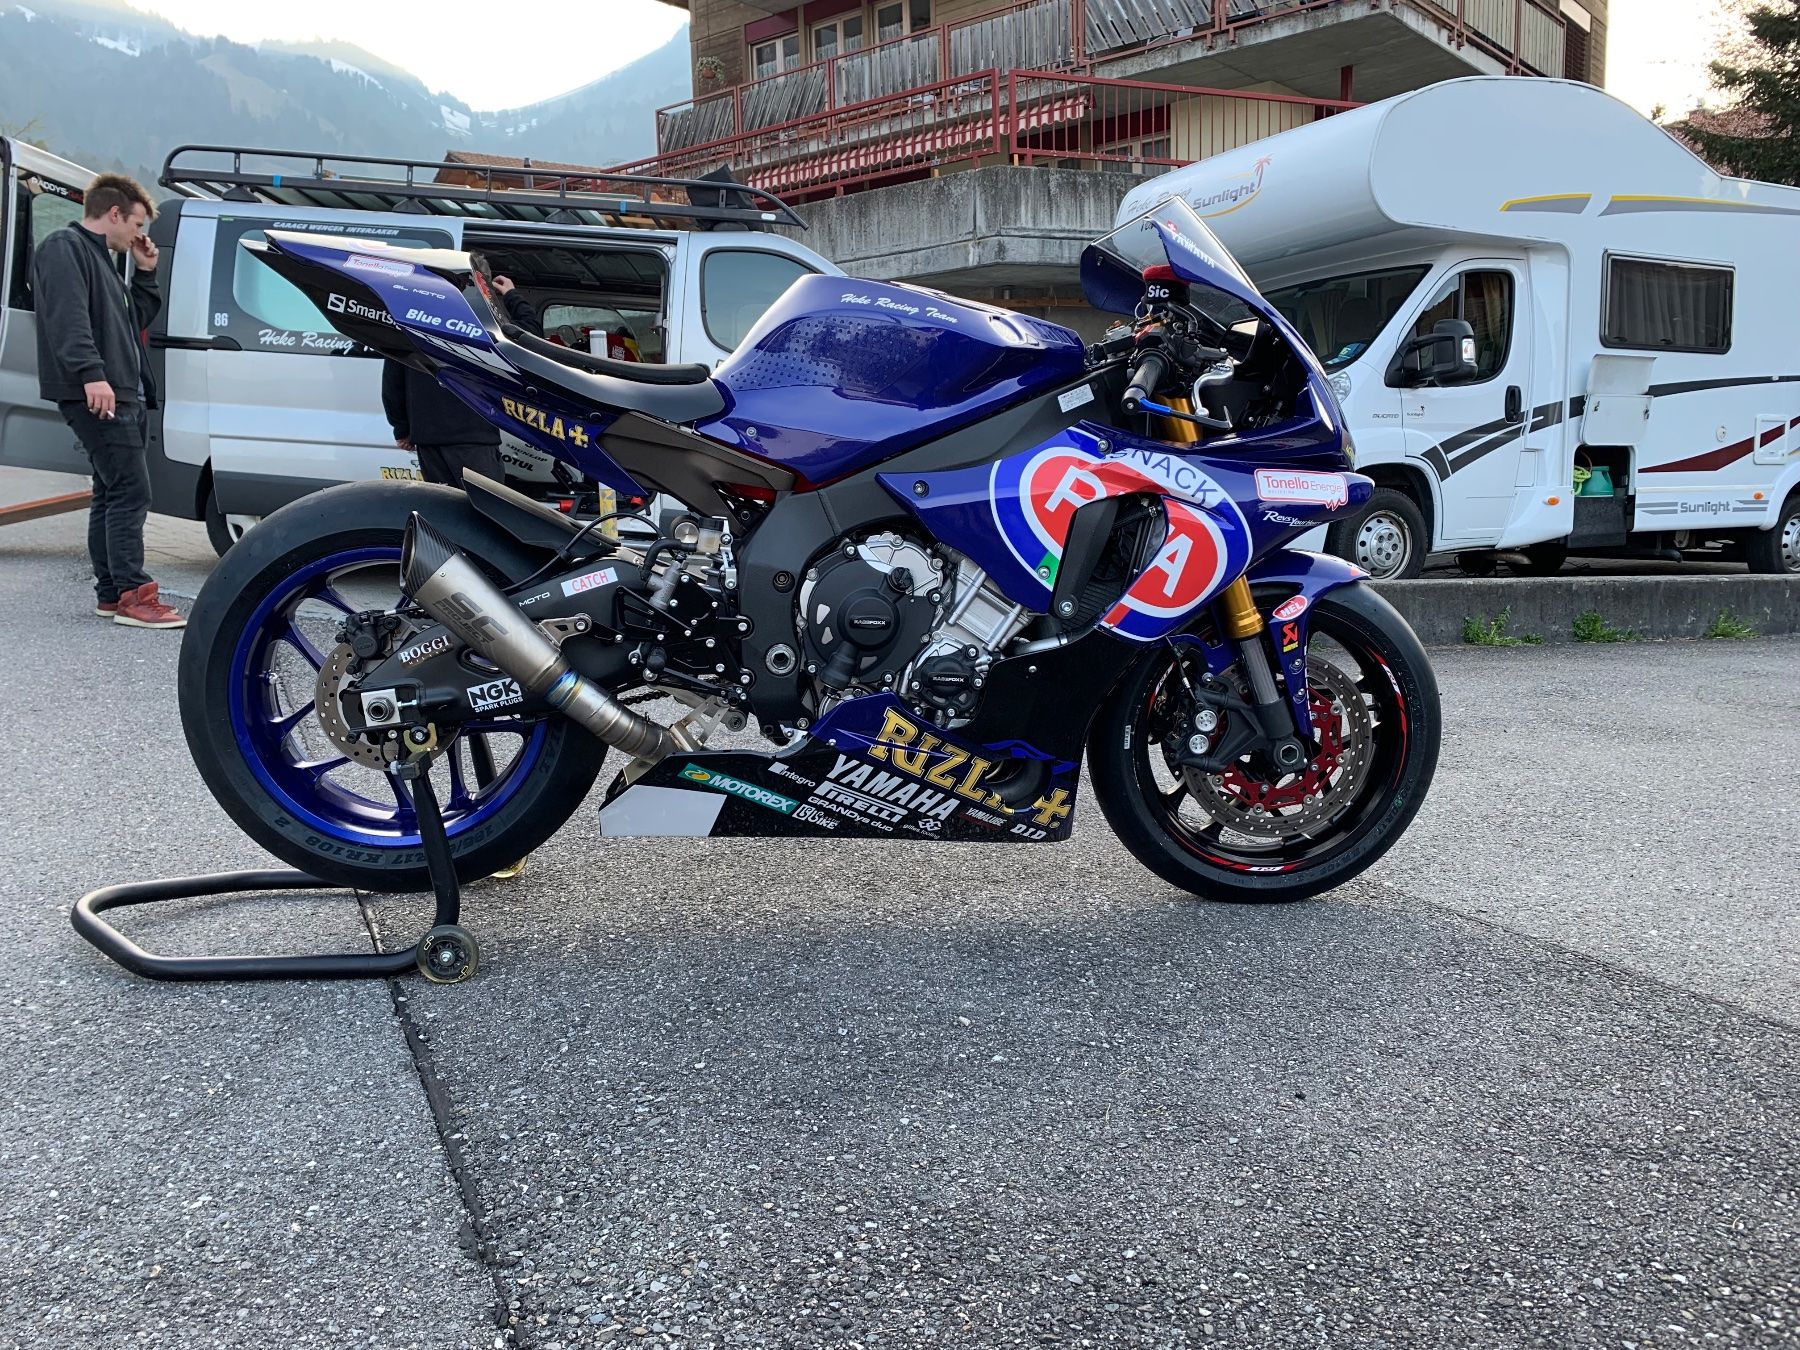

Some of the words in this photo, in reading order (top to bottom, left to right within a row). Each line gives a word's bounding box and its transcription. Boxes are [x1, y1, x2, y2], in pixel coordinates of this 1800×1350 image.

[1193, 182, 1256, 210] Sunlight
[273, 222, 308, 230] GARAGE
[309, 224, 345, 232] WENGER
[346, 226, 400, 236] INTERLAKEN
[1147, 285, 1170, 298] Sic
[214, 312, 228, 327] 86
[347, 299, 402, 331] Smarts
[841, 293, 871, 305] Heke
[874, 297, 920, 314] Racing
[925, 307, 959, 324] Team
[405, 308, 442, 326] Blue
[445, 318, 483, 338] Chip
[259, 328, 296, 345] Heke
[301, 332, 354, 355] Racing
[500, 452, 534, 472] OTUL
[1263, 475, 1309, 490] Tonello
[1263, 510, 1293, 523] Revs
[1680, 501, 1731, 516] Sunlight
[1044, 465, 1194, 598] PA
[571, 571, 609, 593] CATCH
[518, 591, 550, 607] MOTO
[399, 634, 450, 663] BOGGI
[468, 680, 519, 707] NGK
[474, 701, 500, 713] SPARK
[500, 695, 524, 707] PLUGS
[867, 705, 1015, 815] RIZL
[779, 765, 816, 788] integro
[826, 753, 961, 821] YAMAHA
[708, 774, 791, 812] MOTOREX
[813, 780, 909, 823] PIRELLI
[870, 819, 894, 832] duo
[965, 807, 1008, 827] YAMALUBE
[1010, 823, 1047, 840] D.I.D
